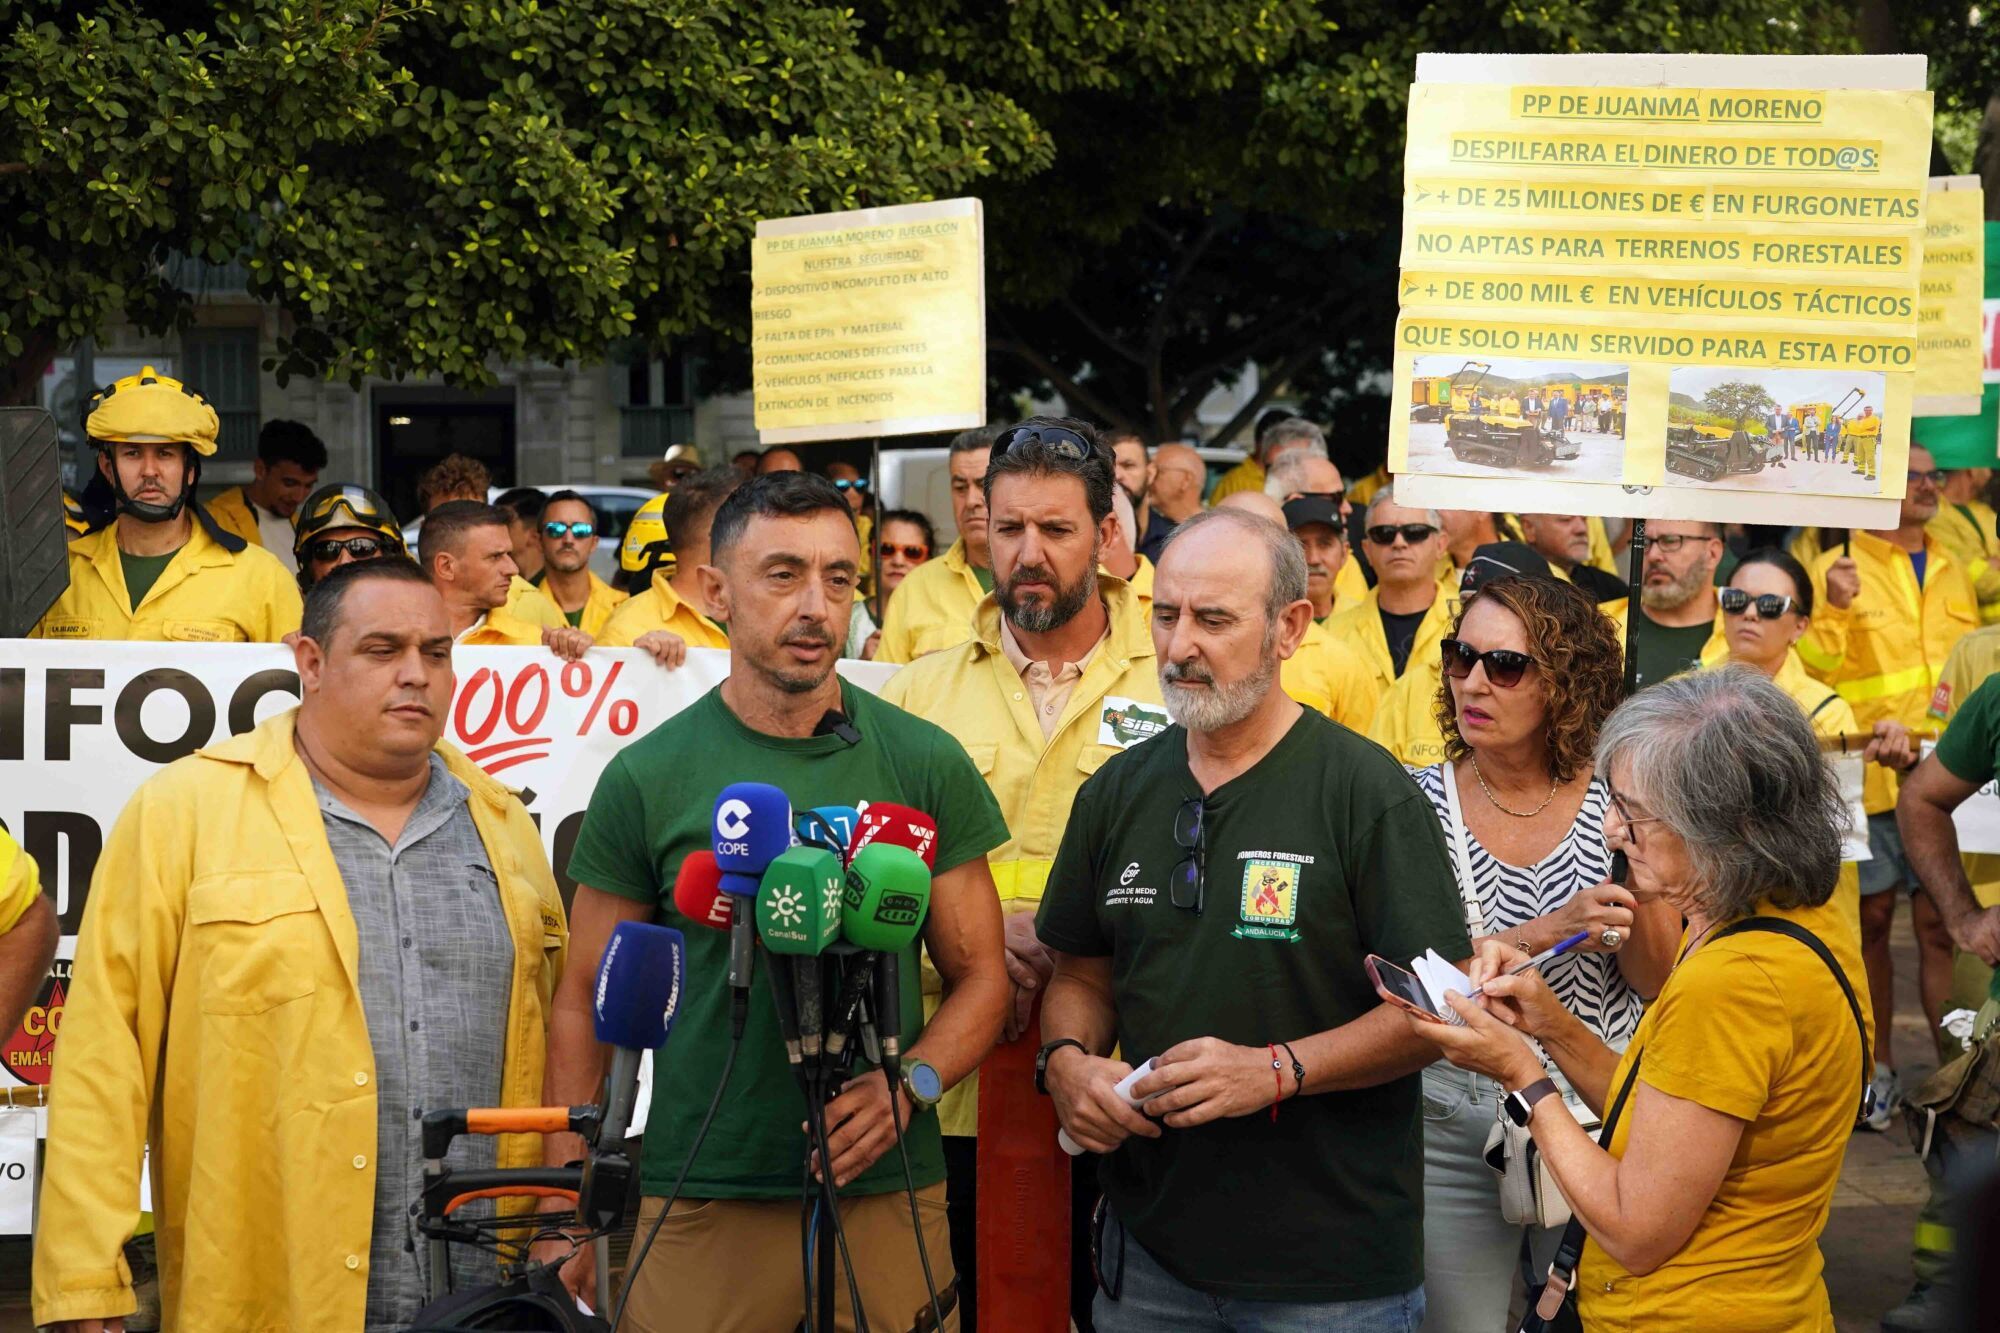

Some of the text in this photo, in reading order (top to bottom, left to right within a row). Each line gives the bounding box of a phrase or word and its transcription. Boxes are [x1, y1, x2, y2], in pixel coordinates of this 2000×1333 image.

[1522, 94, 1822, 119] PP DE JUANMA MORENO
[1452, 139, 1879, 170] DESPILFARRA EL DINERO DE TOD@S:
[1457, 187, 1487, 207] DE
[1494, 189, 1520, 208] 25
[1526, 190, 1644, 212] MILLONES
[1652, 193, 1682, 213] DE
[1690, 194, 1704, 213] €
[1713, 194, 1744, 214] EN
[1752, 195, 1919, 218] FURGONETAS
[767, 222, 959, 250] PP DE JUANMA MORENO JUEGA CON
[1417, 233, 1902, 266] NO APTAS PARA TERRENOS FORESTALES
[804, 257, 852, 270] NUESTRA
[765, 270, 949, 296] DISPOSITIVO INCOMPLETO EN ALTO
[1445, 280, 1475, 300] DE
[1482, 282, 1523, 301] 800
[1530, 283, 1573, 303] MIL
[1580, 284, 1594, 304] €
[1609, 285, 1639, 305] EN
[1647, 284, 1782, 311] VEHÍCULOS
[1793, 288, 1912, 317] TÁCTICOS
[754, 308, 791, 320] RIESGO
[765, 331, 796, 342] FALTA
[798, 330, 812, 340] DE
[841, 326, 848, 335] Y
[851, 322, 904, 335] MATERIAL
[764, 342, 928, 366] COMUNICACIONES DEFICIENTES
[1403, 325, 1911, 365] QUE SOLO HAN SERVIDO PARA ESTA FOTO
[826, 369, 885, 383] INEFICACES
[889, 366, 918, 377] PARA
[920, 365, 934, 376] LA
[816, 397, 829, 407] DE
[837, 392, 895, 405] INCENDIOS
[717, 842, 749, 856] COPE
[1272, 851, 1315, 864] FORESTALES
[1134, 897, 1154, 905] AGUA
